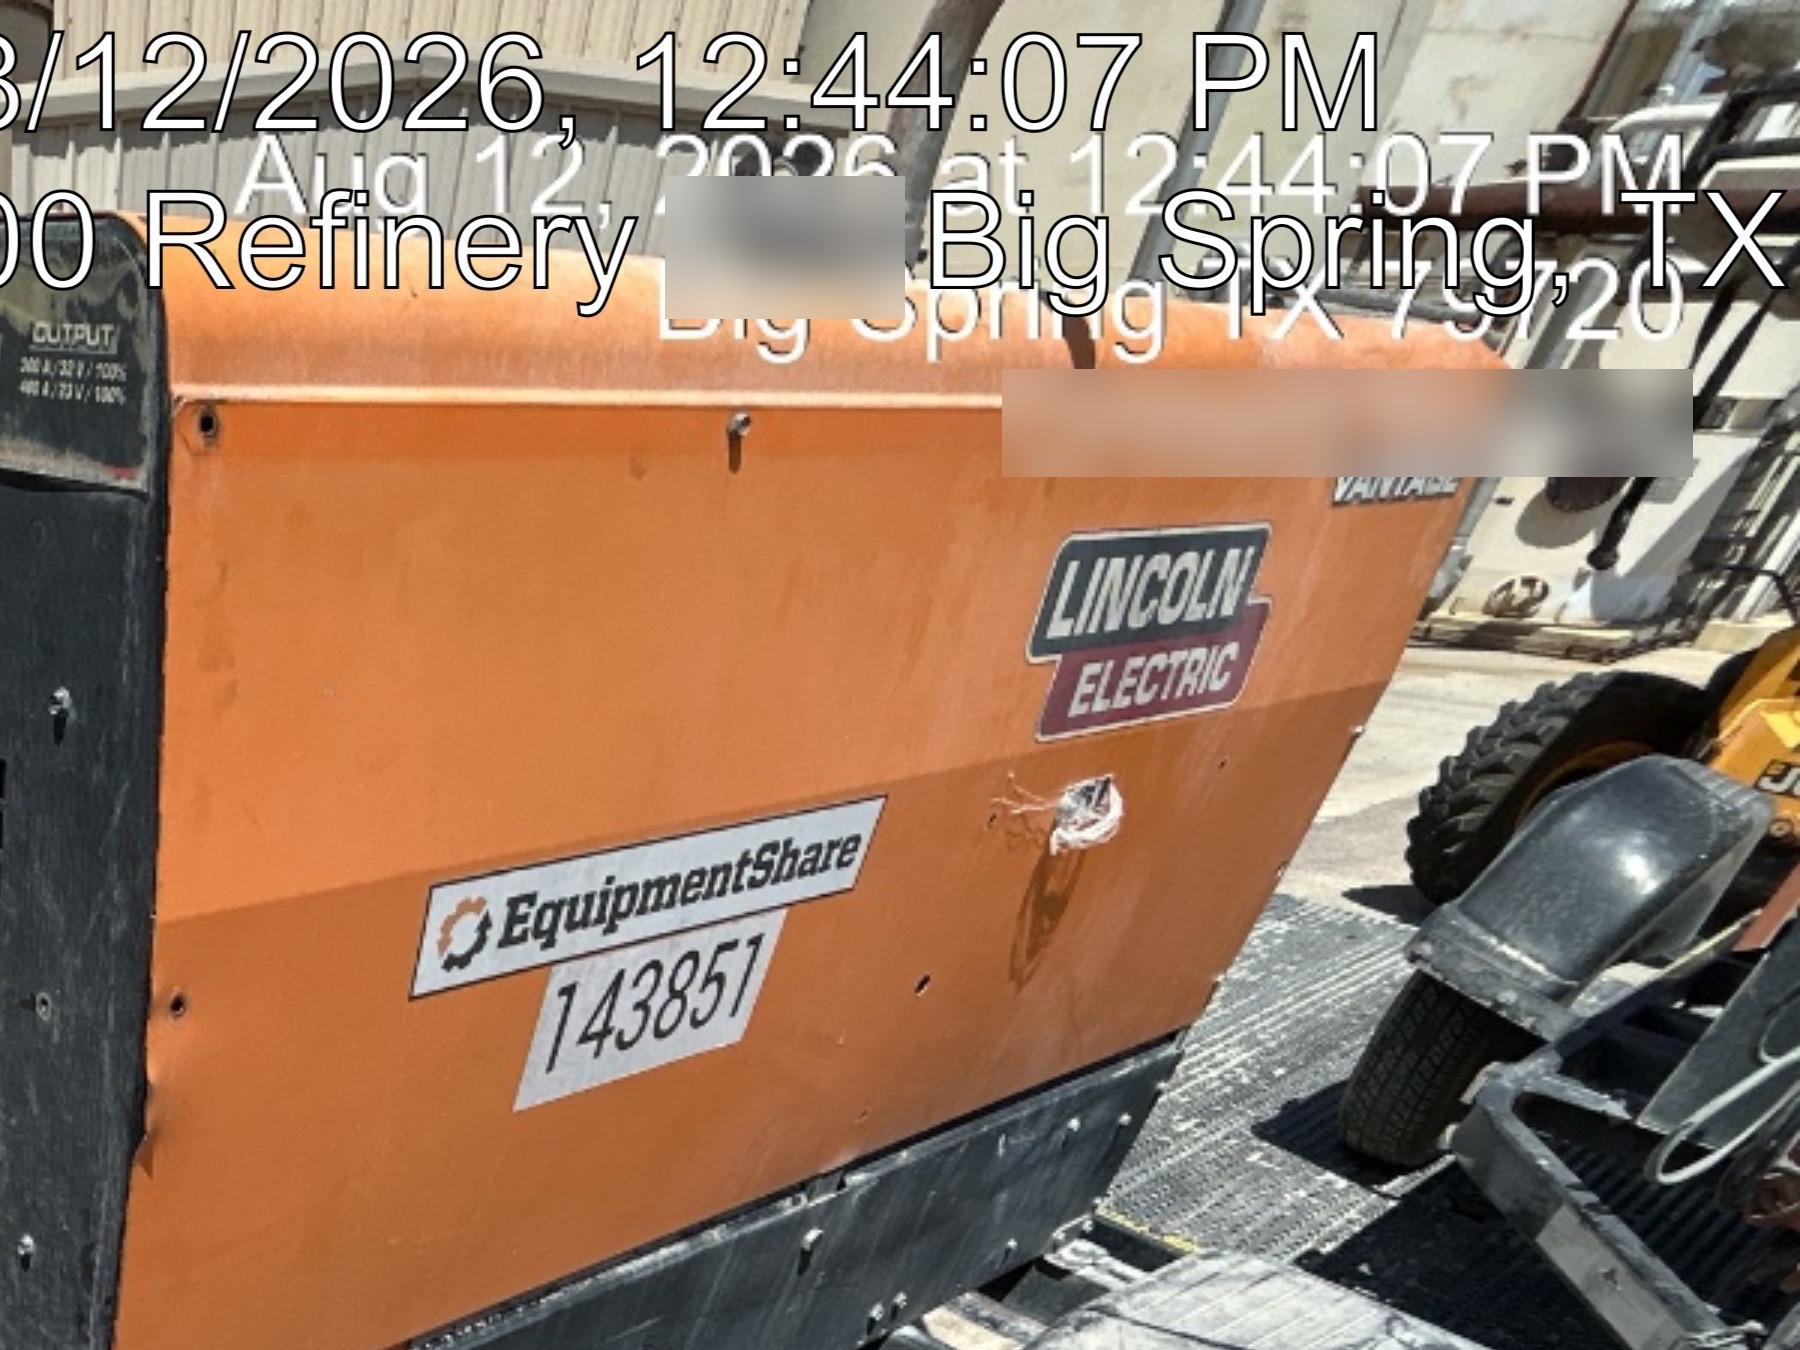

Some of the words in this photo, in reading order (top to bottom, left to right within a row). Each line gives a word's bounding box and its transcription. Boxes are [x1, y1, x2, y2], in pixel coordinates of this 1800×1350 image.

[31, 320, 116, 347] OUTPUT
[1044, 544, 1256, 641] LINCOLN
[1066, 640, 1241, 718] ELECTRIC
[496, 832, 863, 951] EquipmentShare
[546, 932, 767, 1075] 143851
